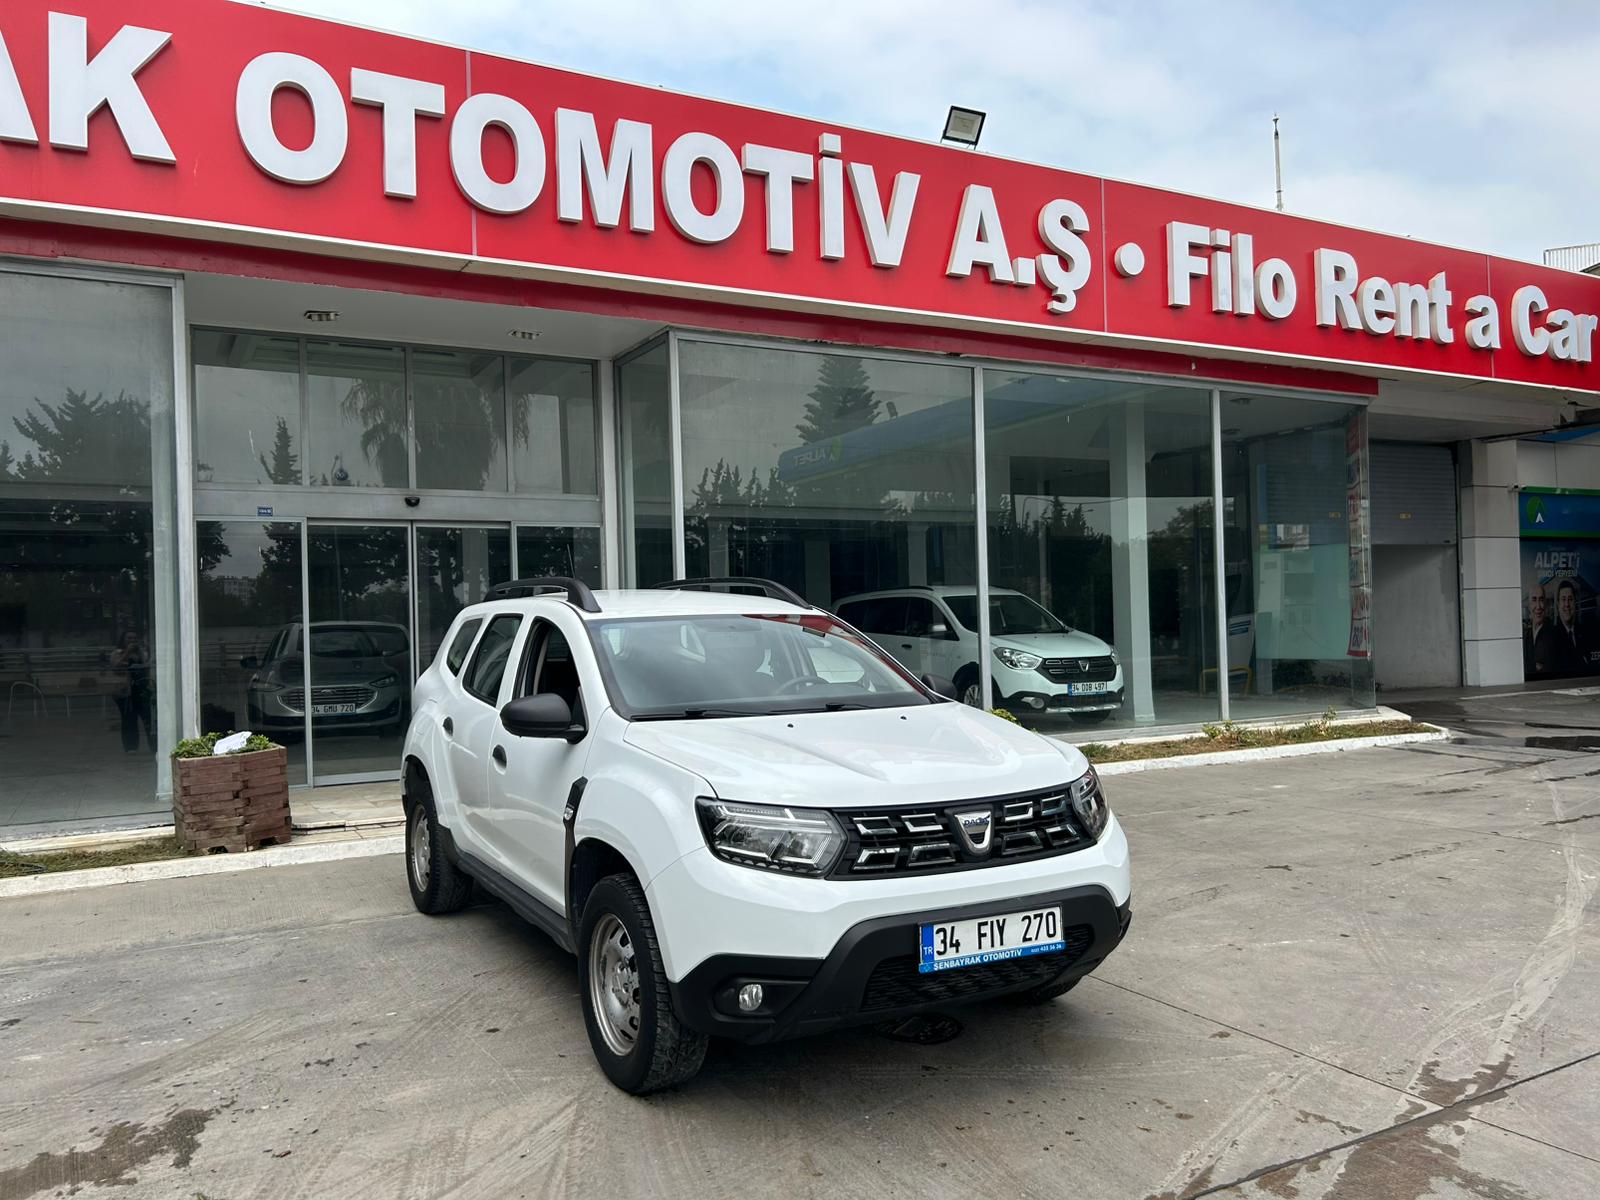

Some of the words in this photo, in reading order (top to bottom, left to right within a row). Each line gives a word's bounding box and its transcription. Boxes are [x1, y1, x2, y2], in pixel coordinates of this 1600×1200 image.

[235, 51, 921, 268] OTOMOTİV
[945, 183, 1093, 315] A.Ş
[1166, 221, 1297, 320] Filo
[1314, 247, 1454, 346] Rent
[1464, 294, 1501, 350] a
[1511, 284, 1598, 363] Car
[923, 946, 933, 956] TR
[935, 926, 961, 955] 34
[977, 918, 1006, 950] FIY
[1021, 910, 1057, 943] 270
